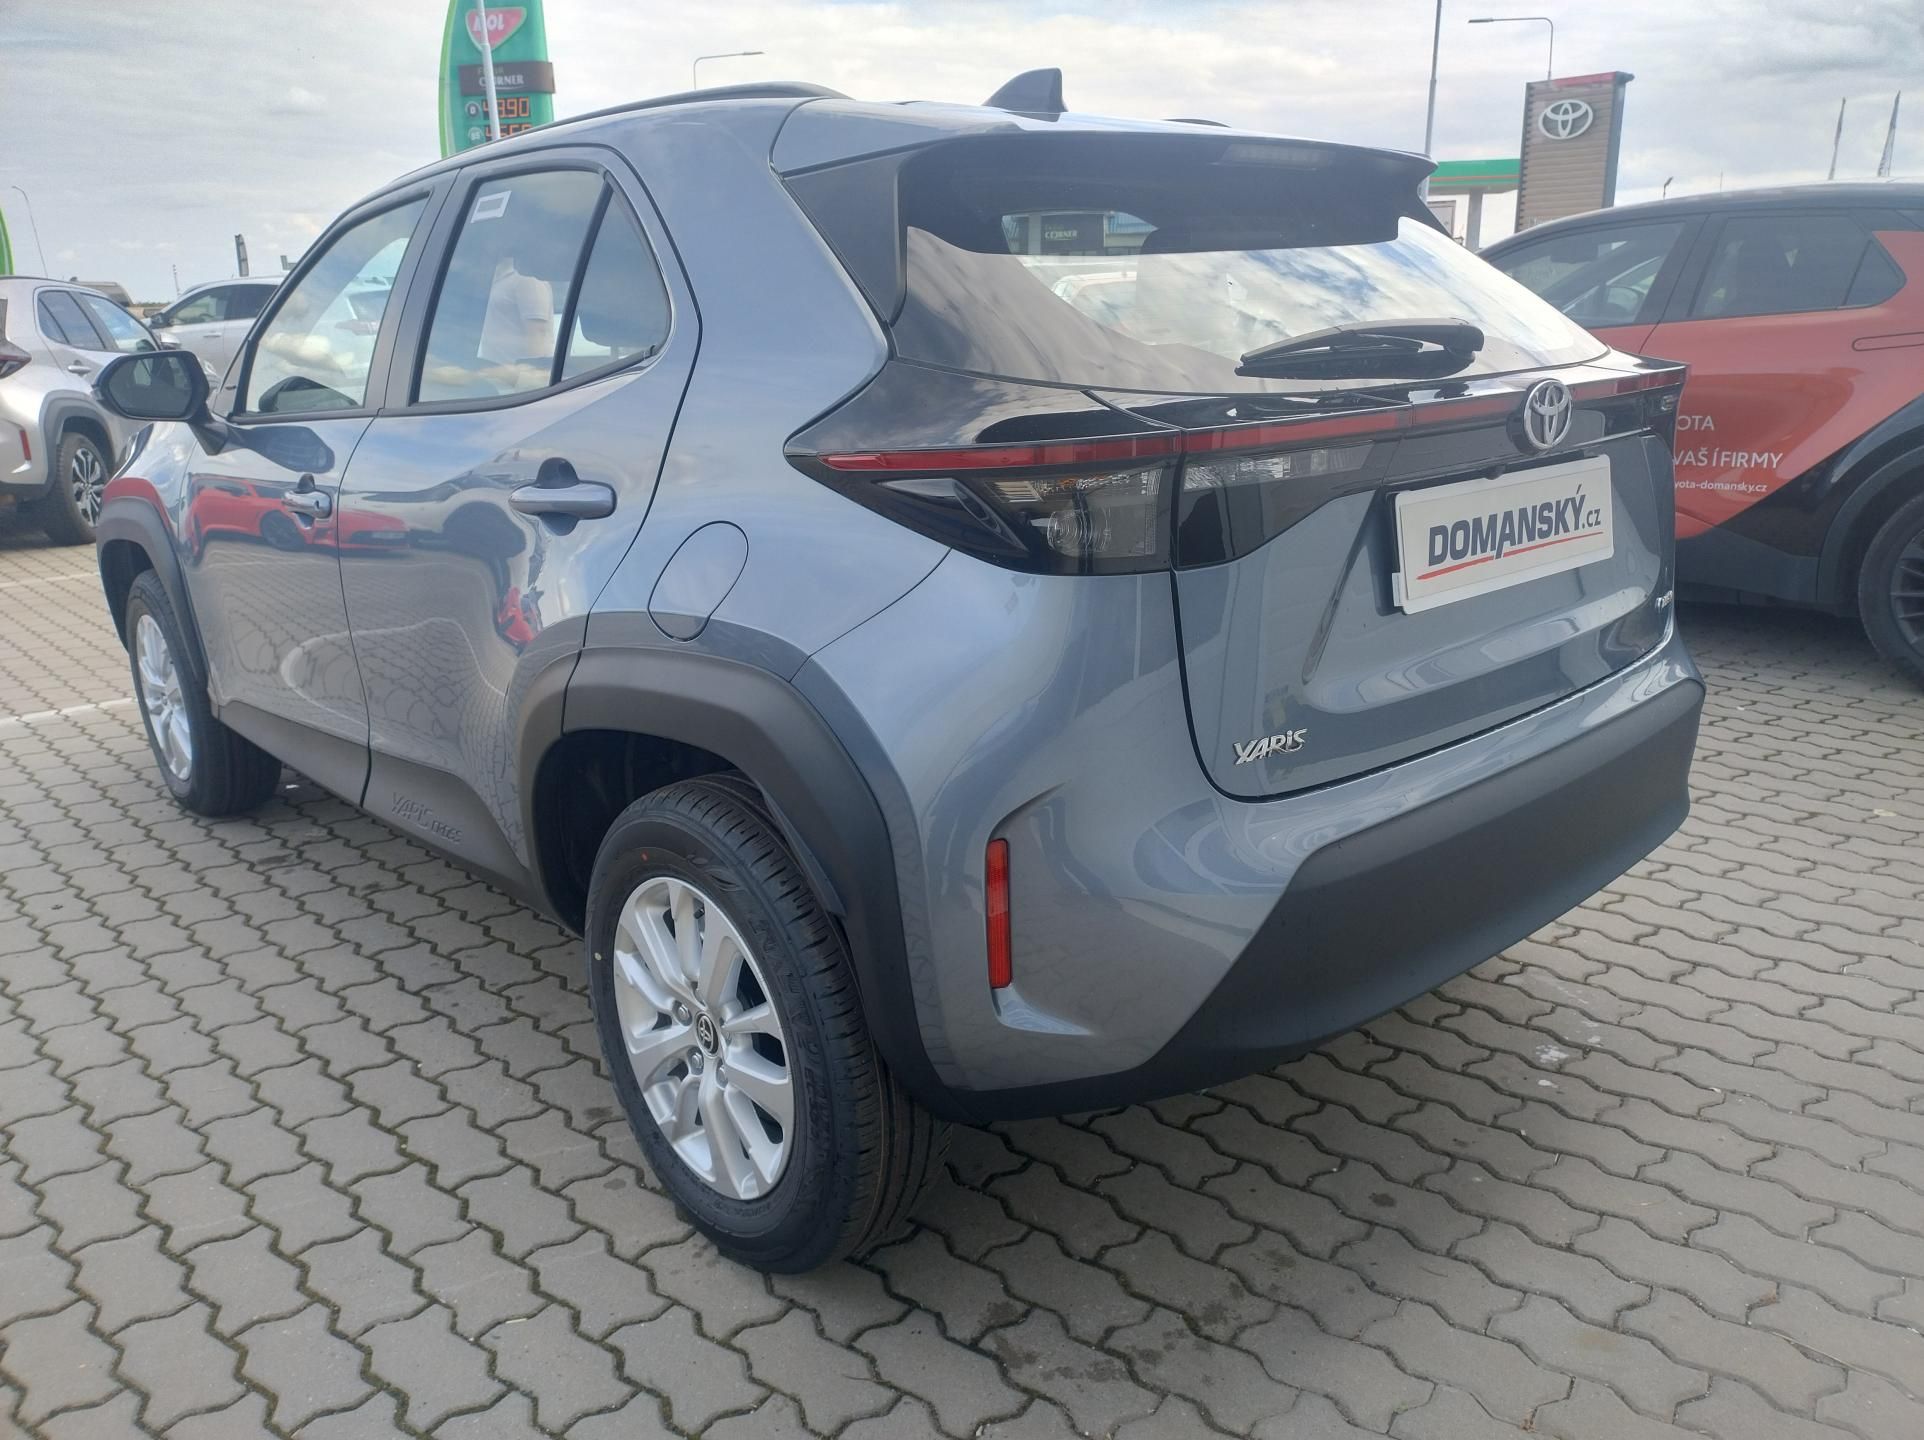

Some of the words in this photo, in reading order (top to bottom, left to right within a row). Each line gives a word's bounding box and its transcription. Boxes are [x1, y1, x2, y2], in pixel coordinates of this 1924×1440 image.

[479, 75, 524, 87] CRNER
[1720, 451, 1783, 469] FIRMY
[1233, 728, 1308, 765] YARIS
